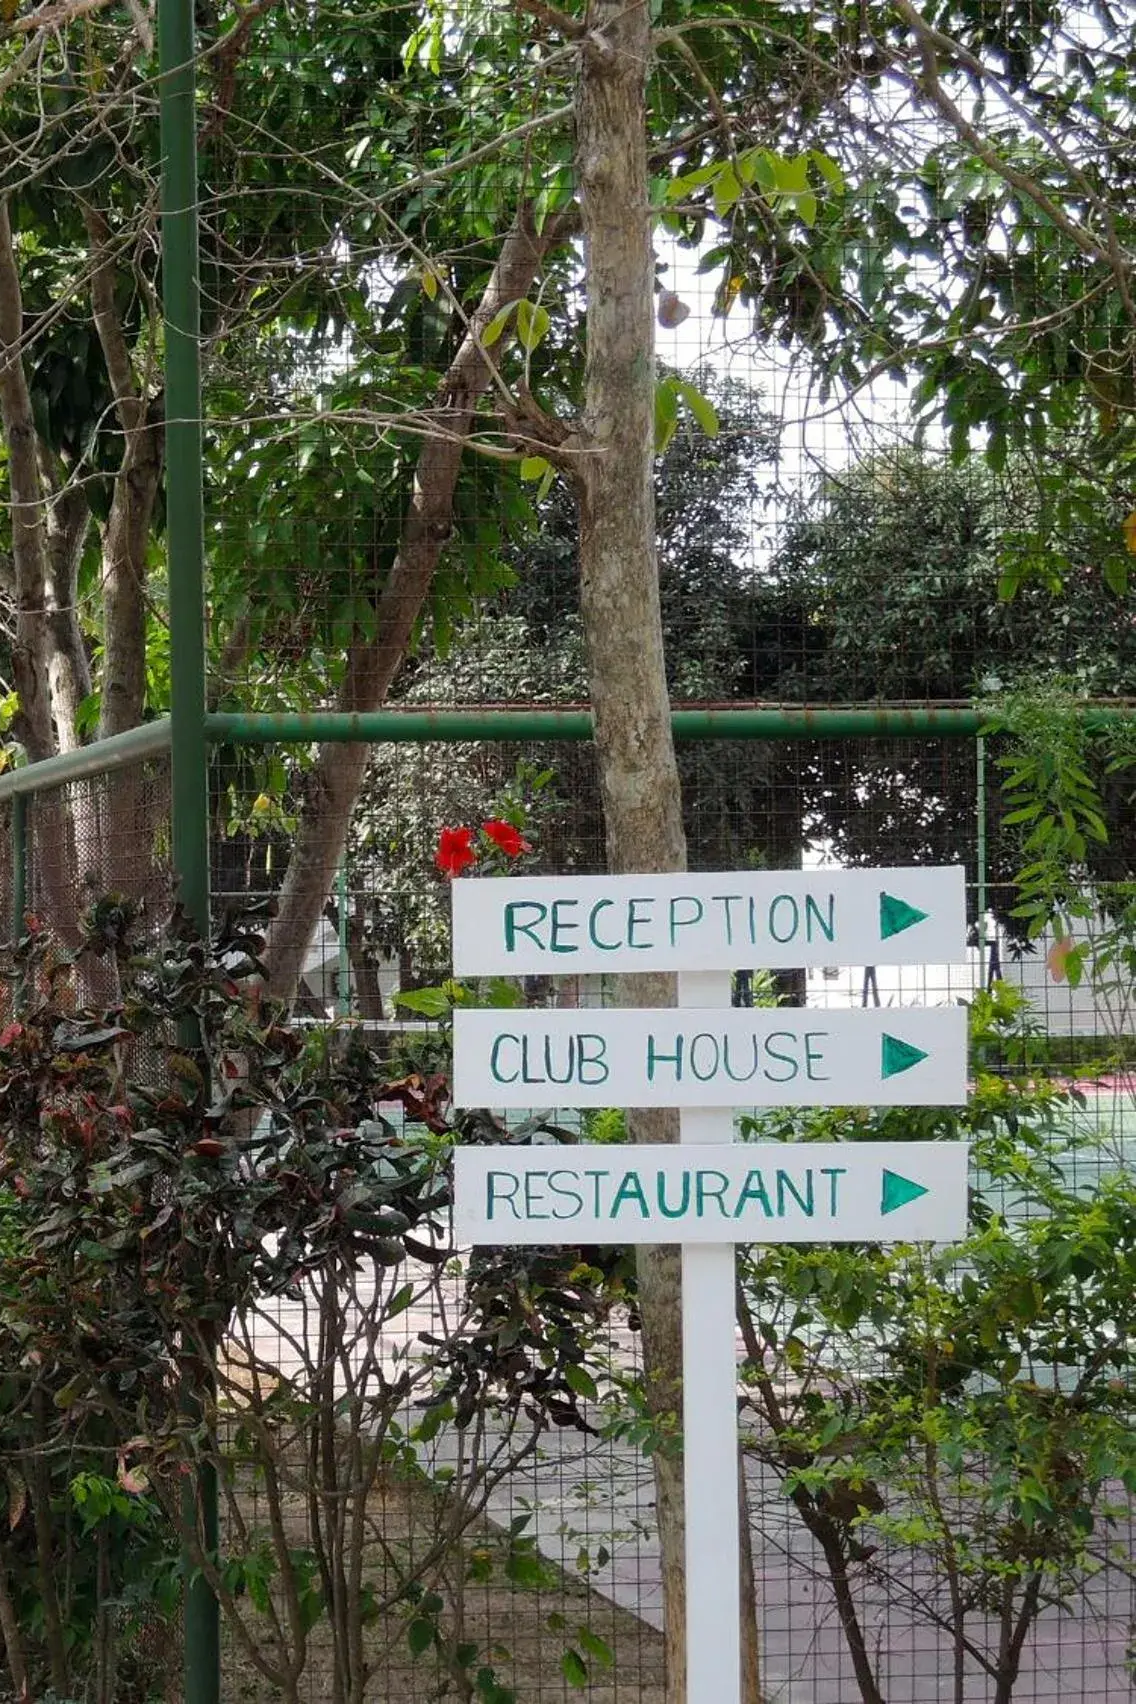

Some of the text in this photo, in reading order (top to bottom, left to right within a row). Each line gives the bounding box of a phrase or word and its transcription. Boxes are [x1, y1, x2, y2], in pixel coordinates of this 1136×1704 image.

[503, 893, 836, 953] RECEPTION
[489, 1031, 832, 1086] CLUB HOUSE
[485, 1167, 848, 1220] RESTAURANT
